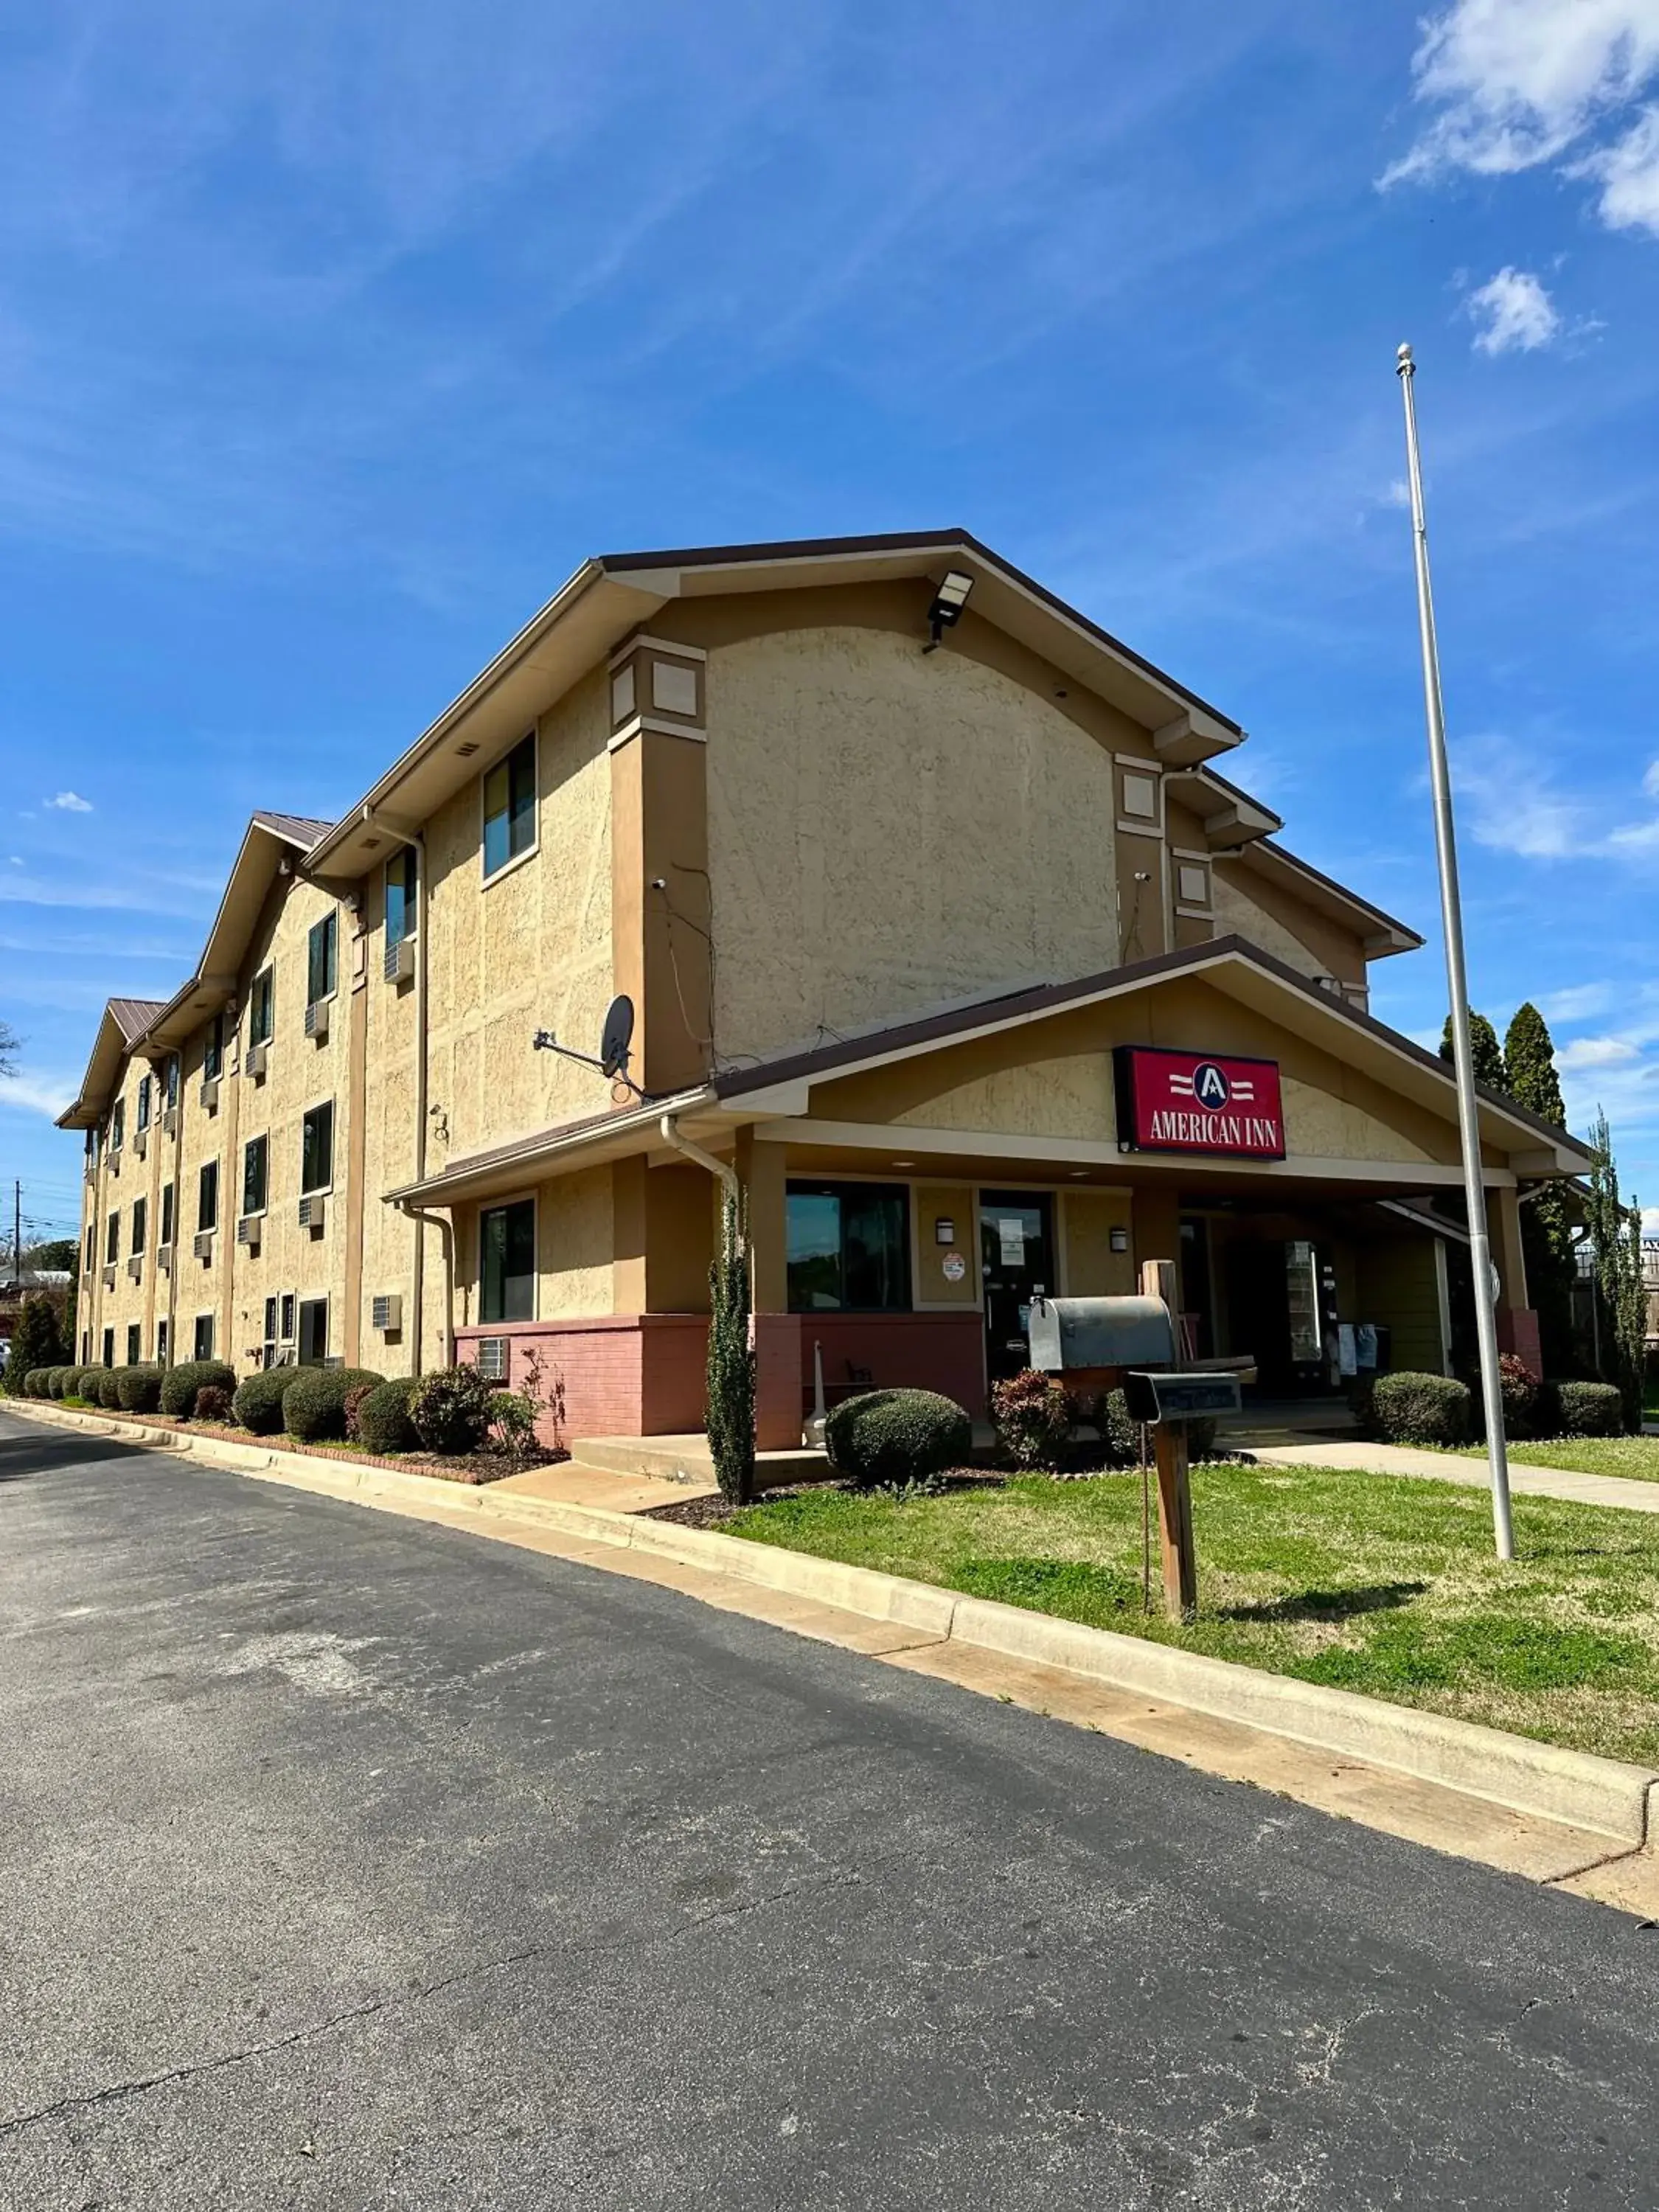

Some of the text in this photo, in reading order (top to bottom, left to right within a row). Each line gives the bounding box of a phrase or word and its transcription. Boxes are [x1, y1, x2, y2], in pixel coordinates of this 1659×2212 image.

[1201, 1068, 1225, 1099] A
[1150, 1110, 1277, 1149] AMERICAN INN
